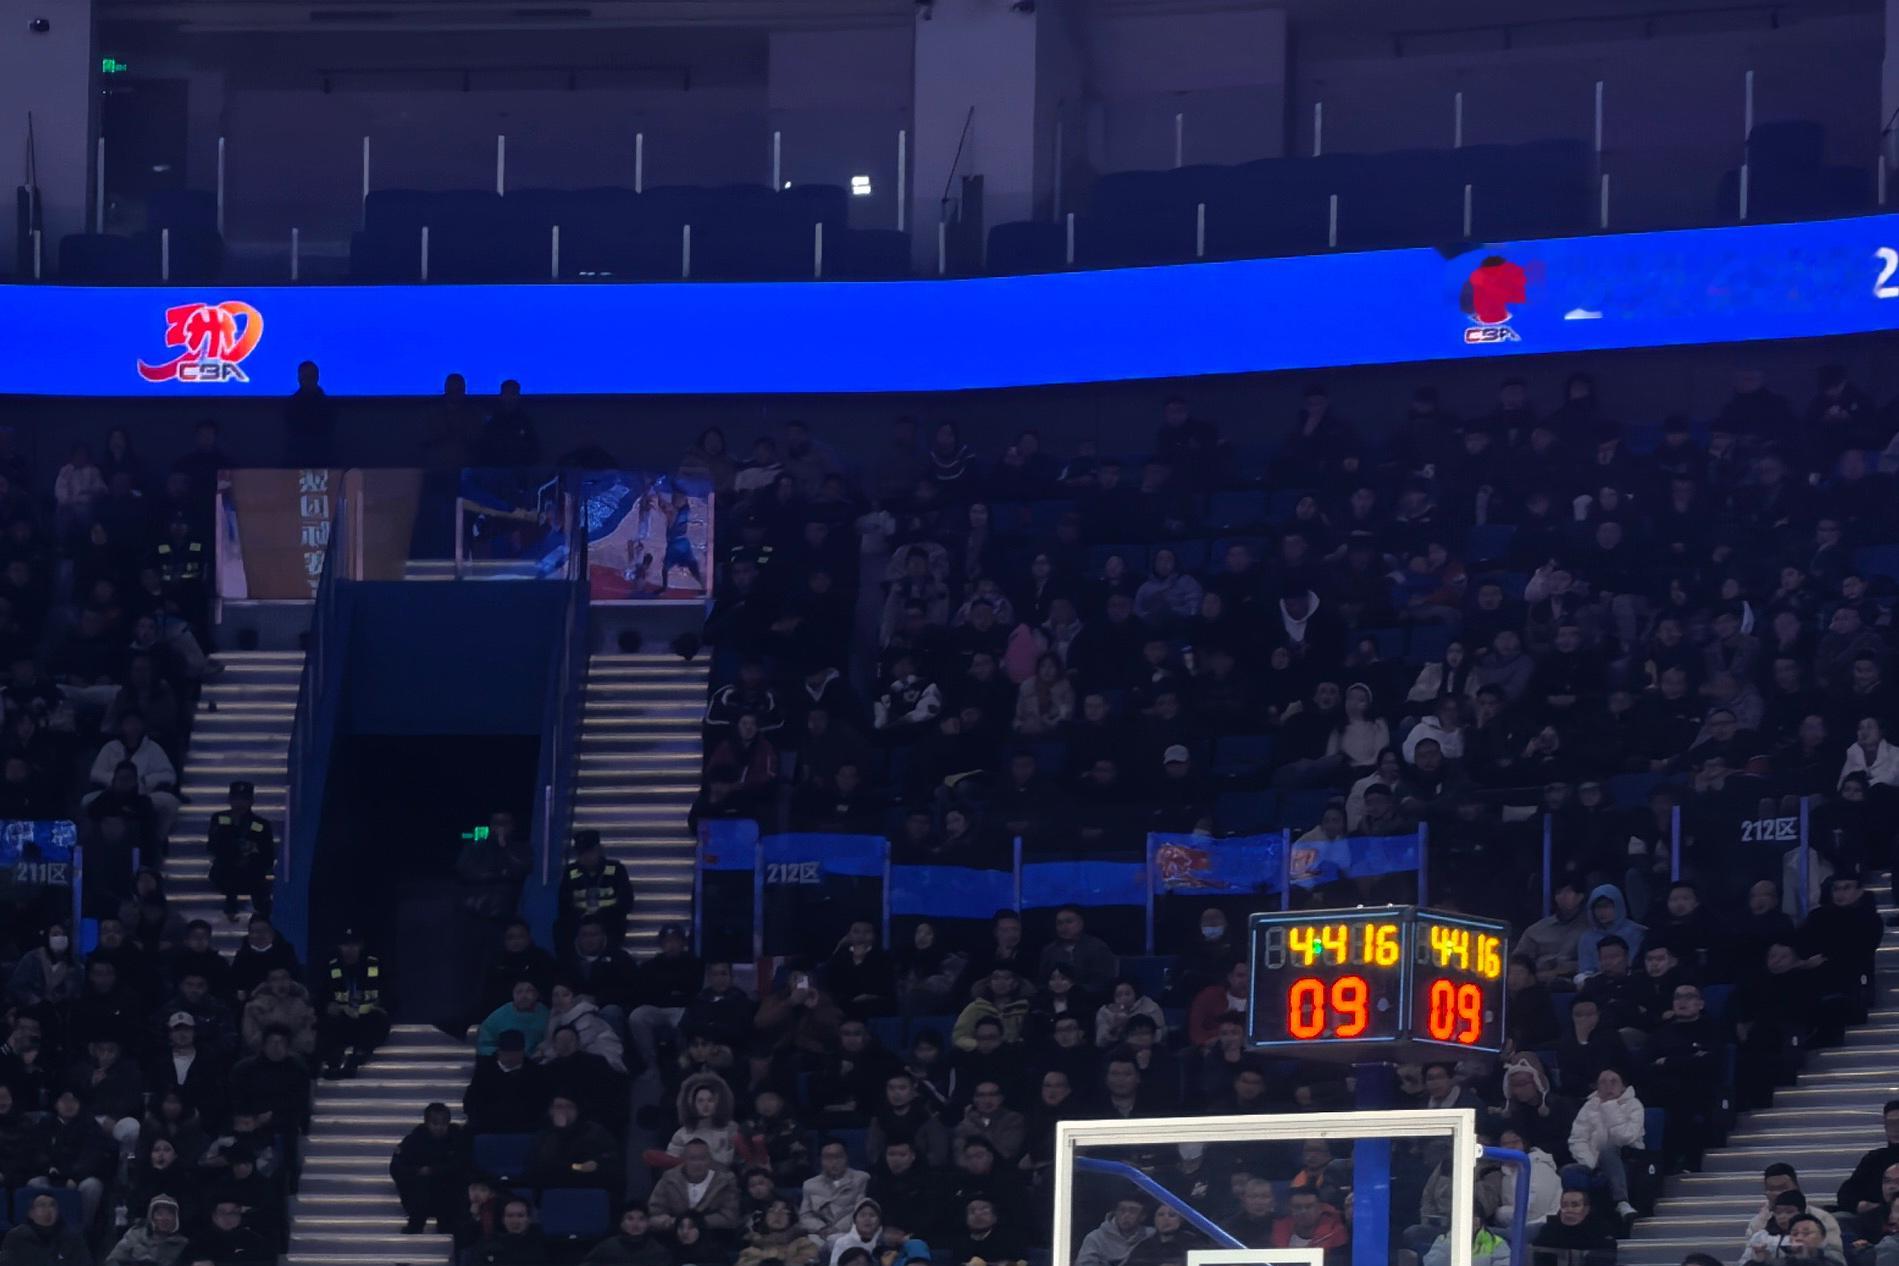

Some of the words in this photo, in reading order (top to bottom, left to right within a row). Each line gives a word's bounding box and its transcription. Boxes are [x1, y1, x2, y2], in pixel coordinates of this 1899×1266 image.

[1464, 325, 1522, 345] CBA
[177, 361, 250, 383] CBA
[1741, 816, 1798, 842] 212区
[17, 861, 68, 885] 211区
[767, 861, 821, 884] 212区
[1288, 975, 1369, 1041] 09
[1429, 978, 1482, 1045] 09
